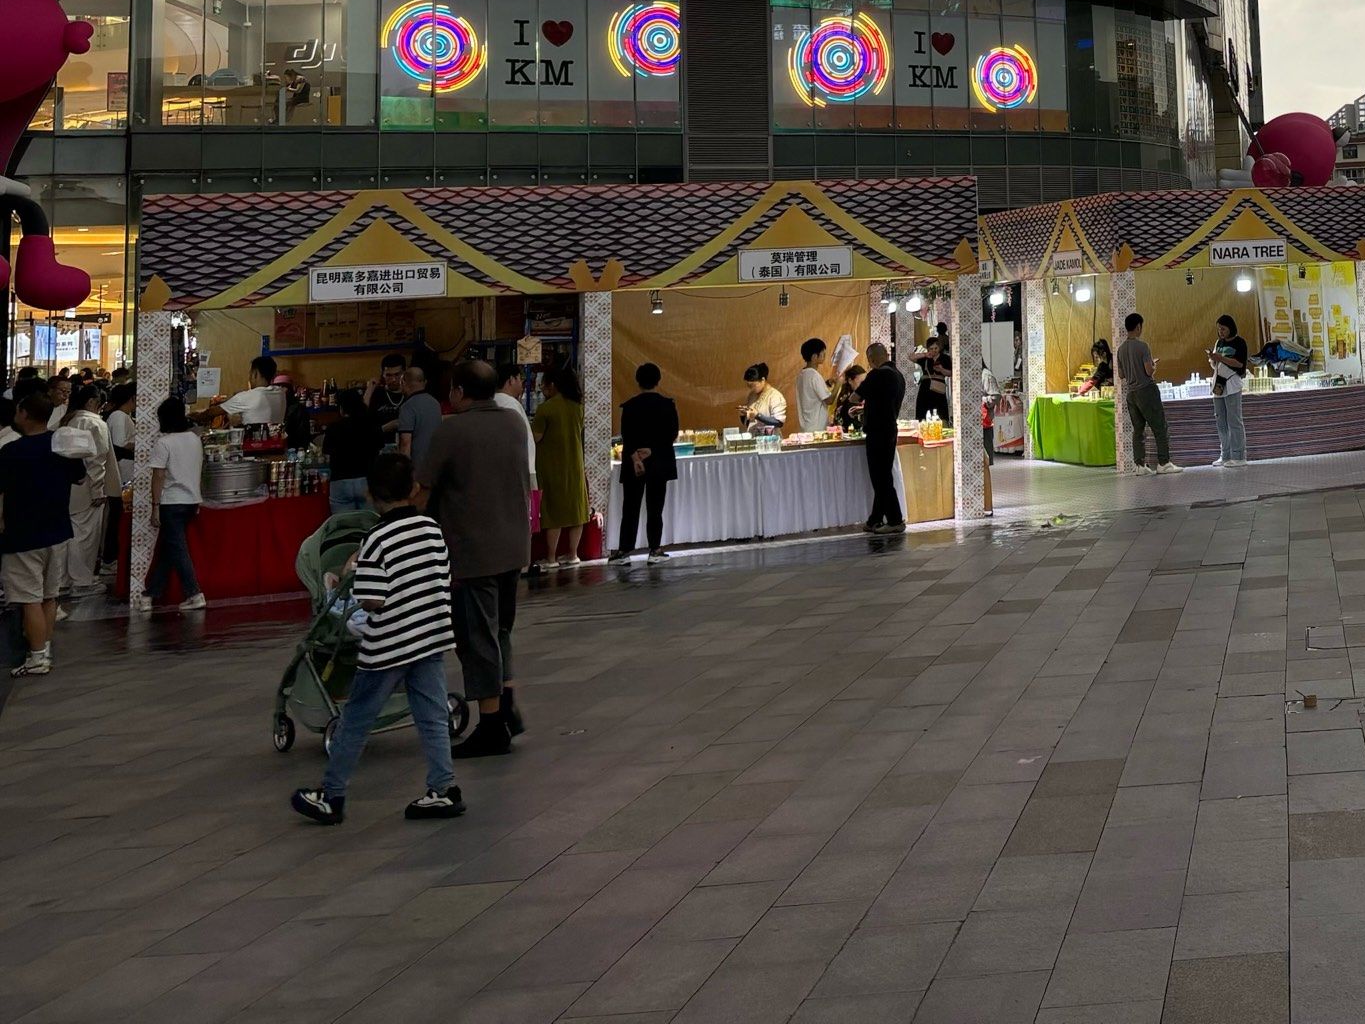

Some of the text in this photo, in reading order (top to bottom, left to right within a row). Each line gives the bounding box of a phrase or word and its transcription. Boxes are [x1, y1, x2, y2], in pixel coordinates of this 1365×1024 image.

[514, 19, 529, 45] I
[914, 31, 926, 54] I
[505, 58, 574, 87] KM
[908, 65, 958, 88] KM
[1213, 245, 1284, 260] NARA TREE
[316, 268, 441, 285] 昆明嘉多嘉进出口贸易
[353, 282, 404, 296] 有限公司
